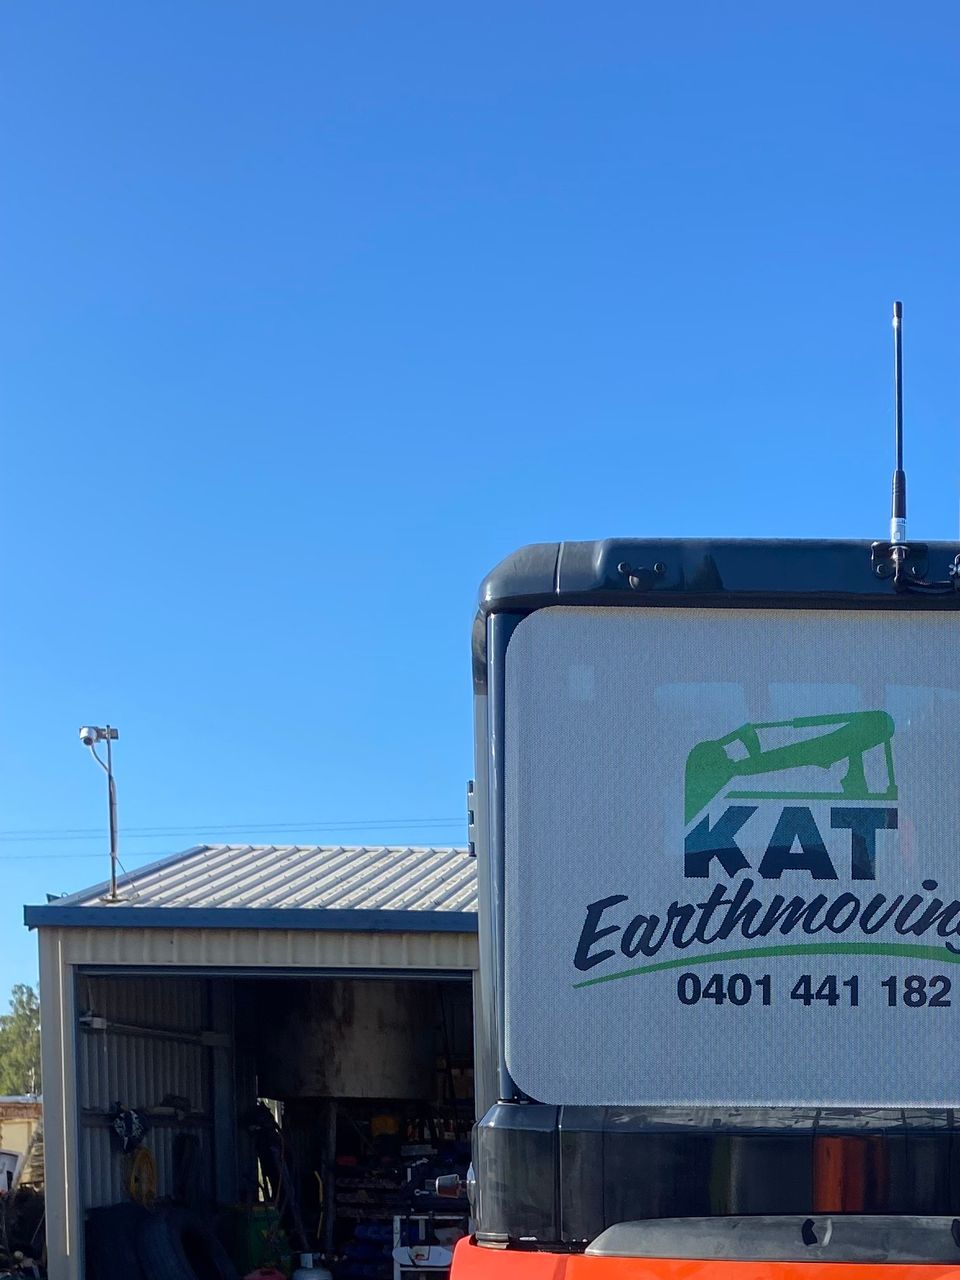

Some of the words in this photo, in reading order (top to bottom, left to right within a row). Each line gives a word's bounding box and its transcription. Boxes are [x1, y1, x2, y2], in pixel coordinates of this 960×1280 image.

[684, 806, 898, 880] KAT
[677, 972, 771, 1007] 0401
[790, 973, 859, 1006] 441
[881, 975, 952, 1007] 182
